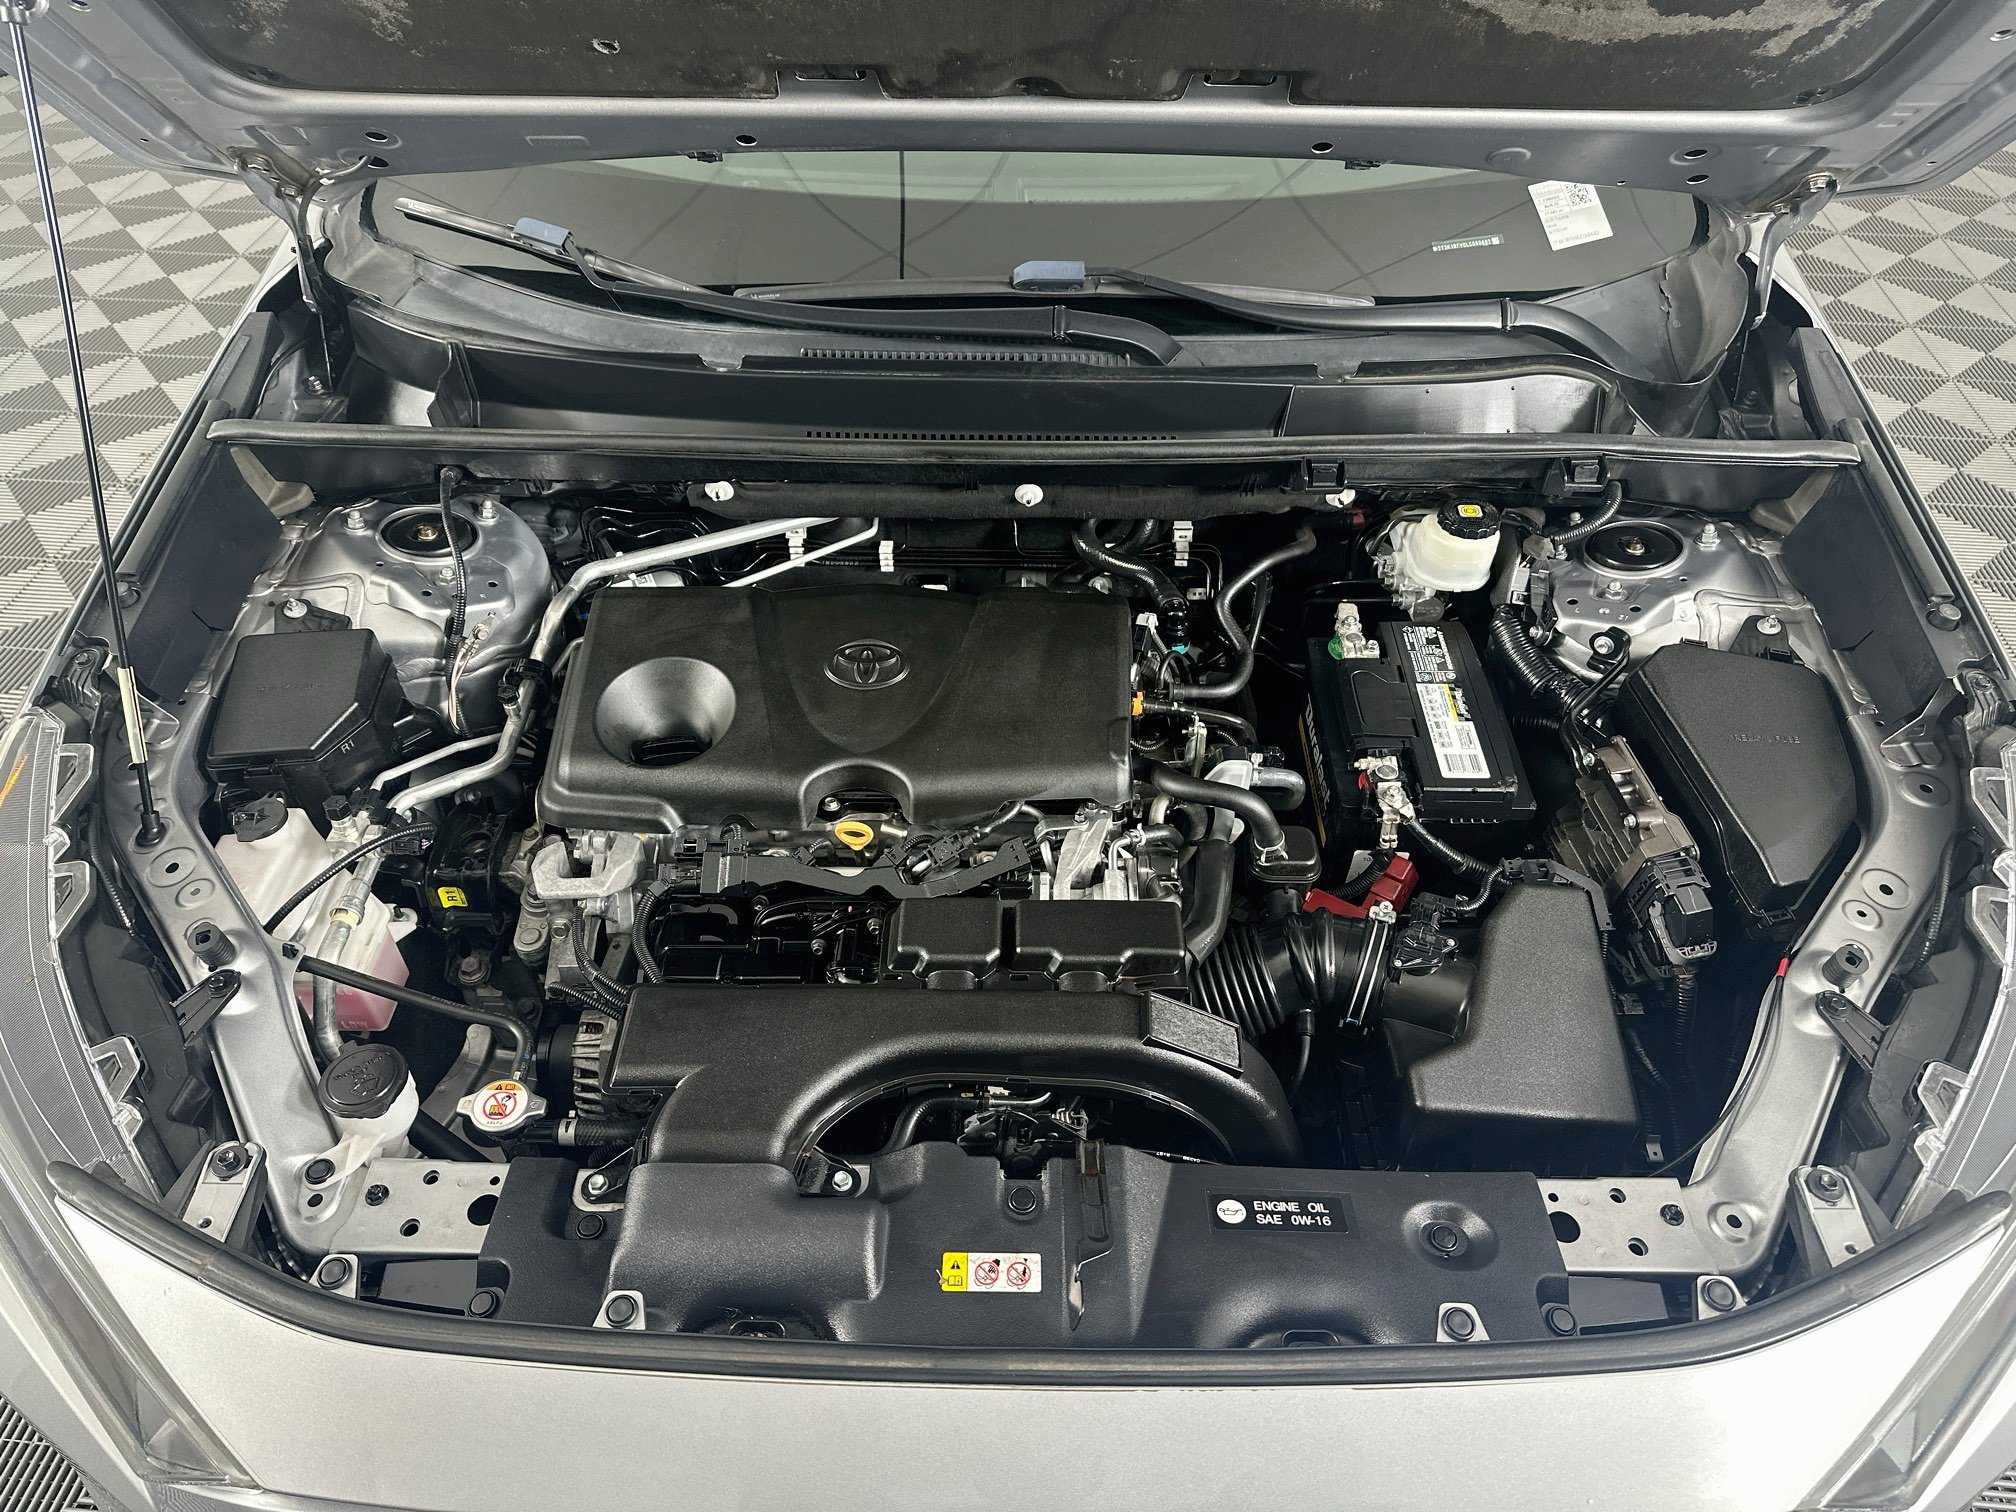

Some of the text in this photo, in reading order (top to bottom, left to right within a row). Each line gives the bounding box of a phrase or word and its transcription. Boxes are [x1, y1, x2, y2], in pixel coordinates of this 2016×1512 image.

[340, 739, 355, 754] R1
[1305, 693, 1331, 811] Duralast
[444, 891, 459, 902] R1
[340, 1021, 369, 1029] LOW
[1253, 1200, 1330, 1213] ENGINE OIL
[1255, 1213, 1332, 1226] SAE 0W-16
